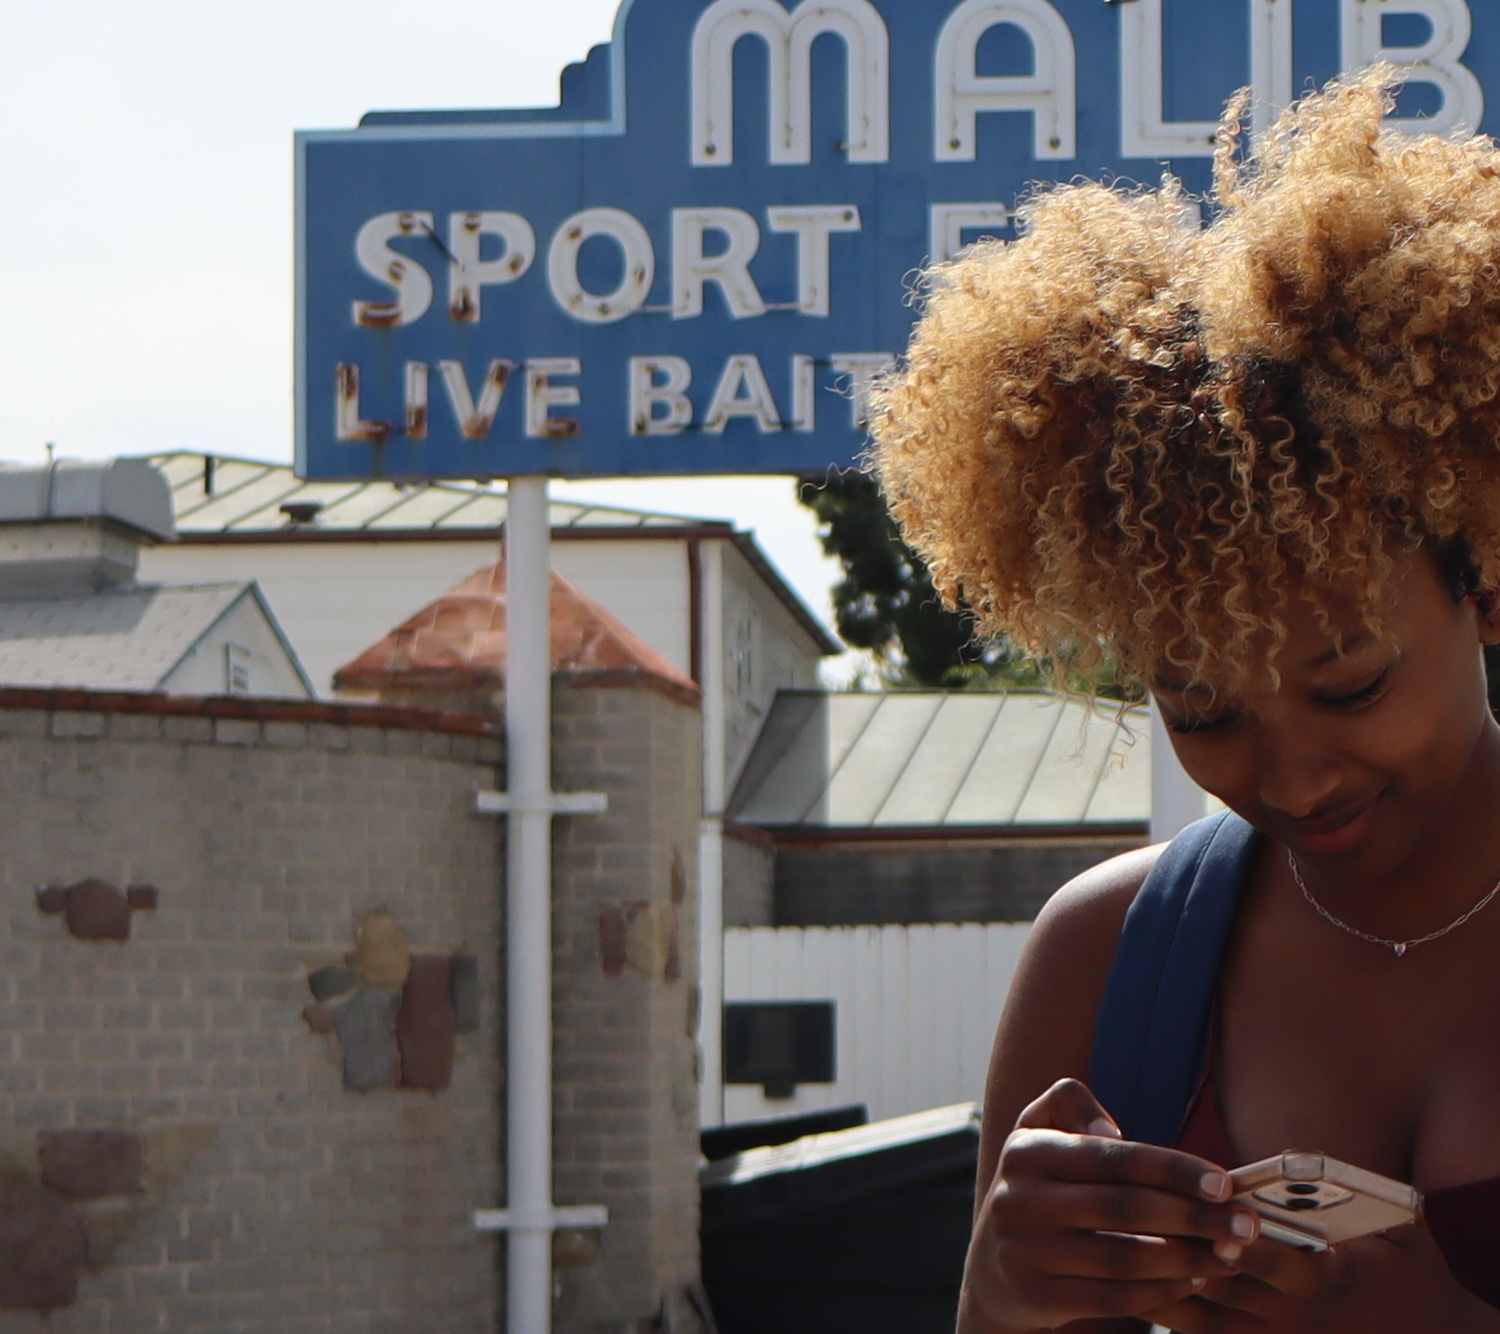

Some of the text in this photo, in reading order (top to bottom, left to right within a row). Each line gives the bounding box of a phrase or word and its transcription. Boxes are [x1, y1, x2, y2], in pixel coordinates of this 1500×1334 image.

[351, 204, 862, 327] SPORT
[335, 357, 582, 441] LIVE
[627, 351, 897, 436] BAIT
